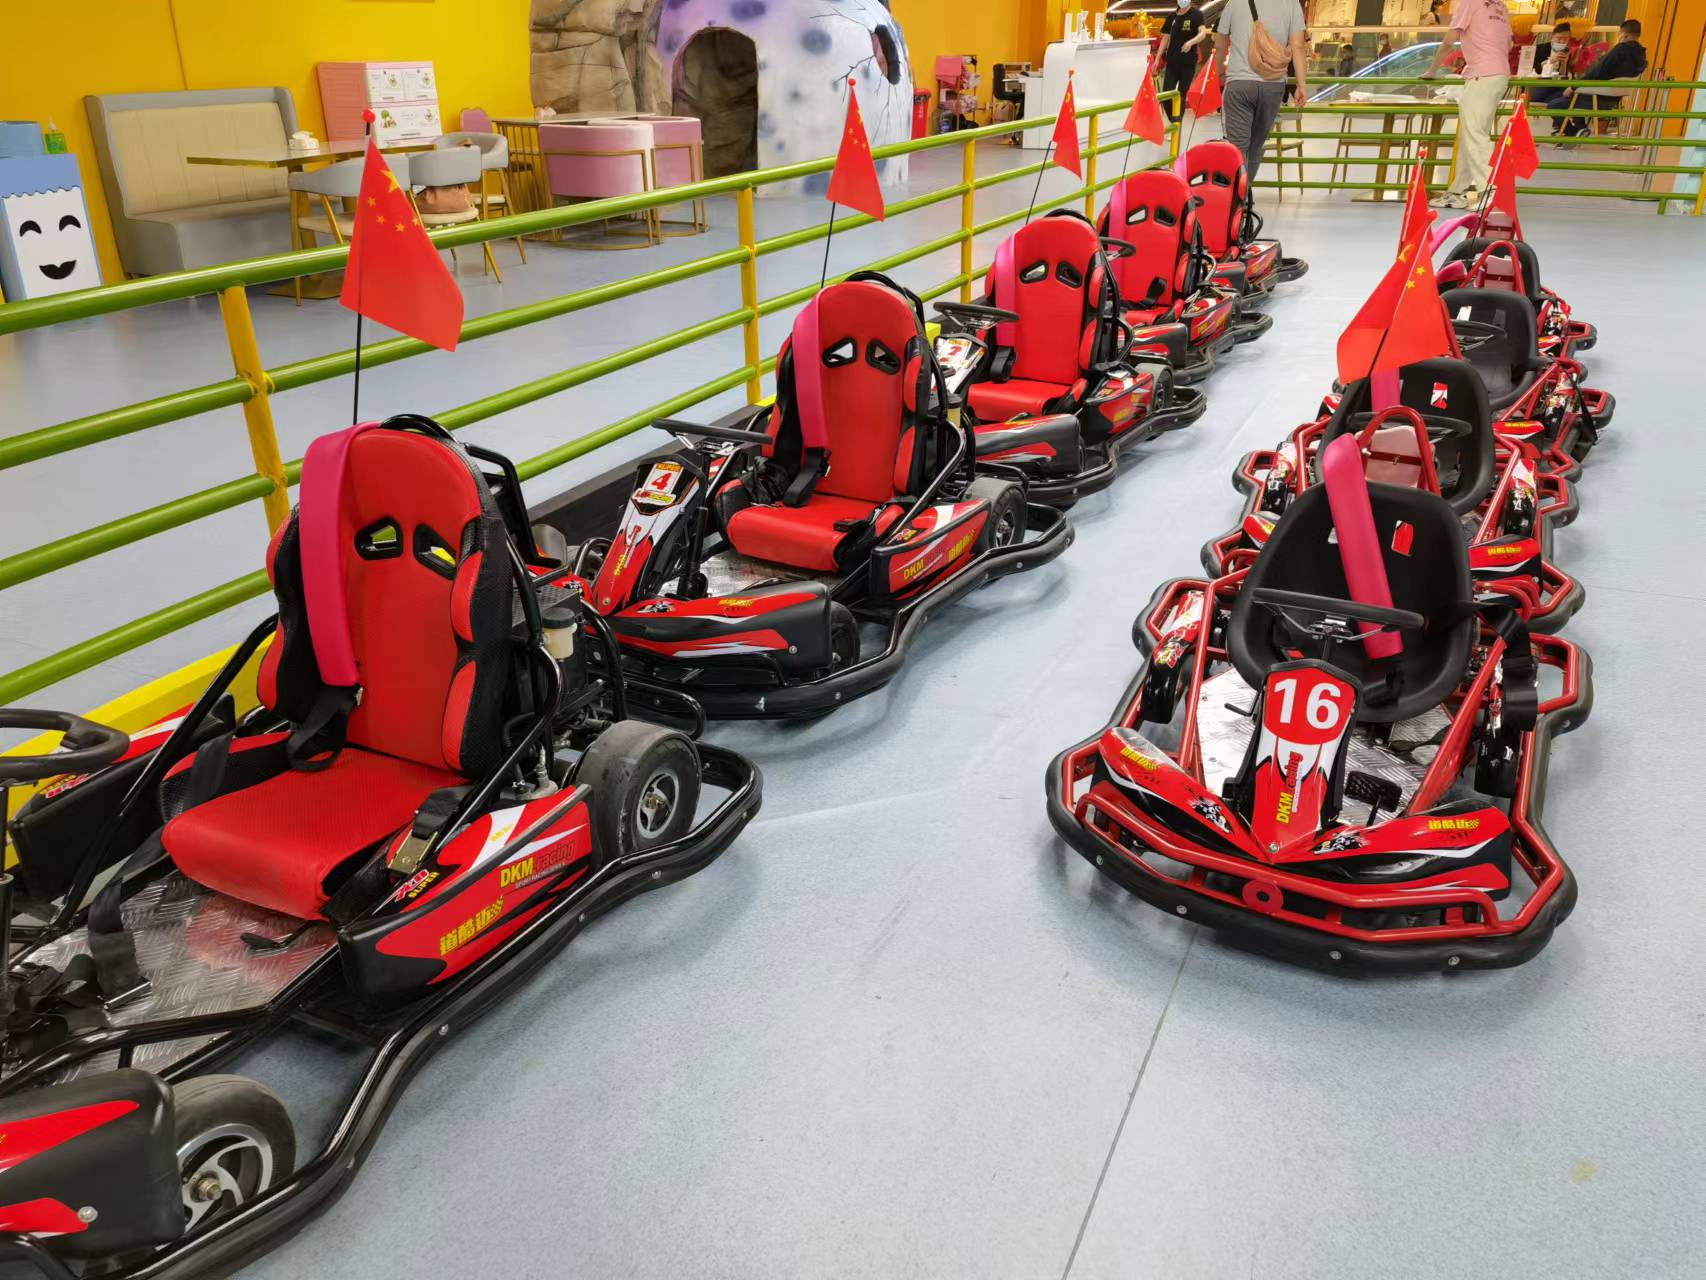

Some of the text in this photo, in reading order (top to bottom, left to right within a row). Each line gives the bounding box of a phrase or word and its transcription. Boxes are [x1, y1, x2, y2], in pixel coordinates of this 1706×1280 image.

[651, 472, 673, 490] 4
[903, 558, 925, 580] DKM
[1274, 678, 1342, 730] 16
[1275, 792, 1294, 824] DKM
[408, 871, 441, 899] SUPER
[500, 857, 534, 888] DKM
